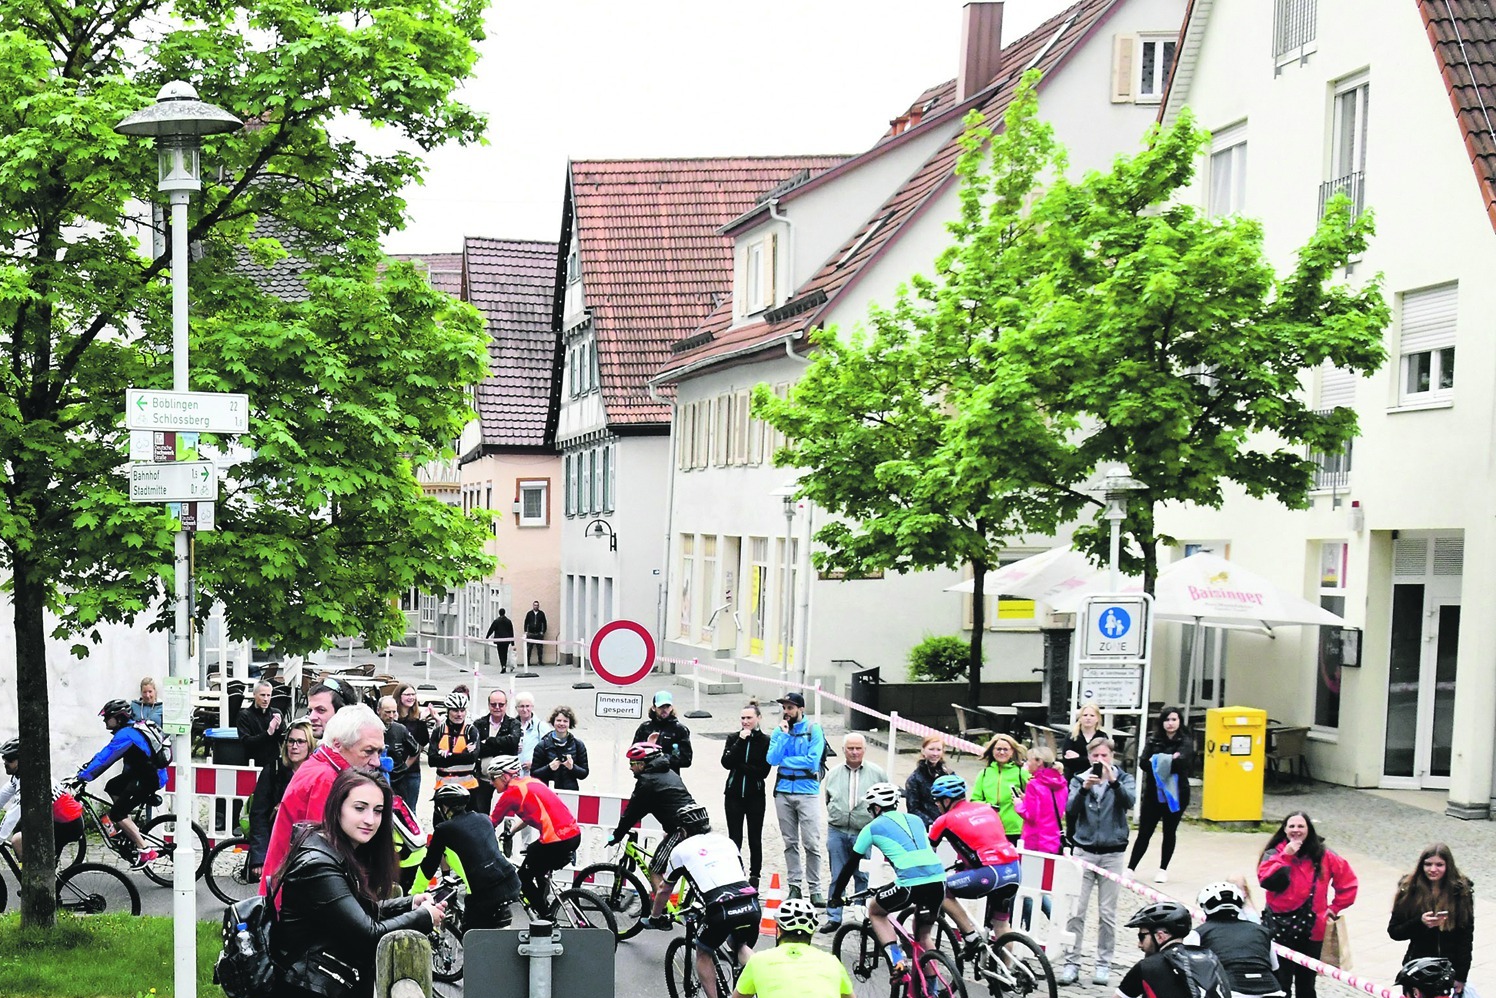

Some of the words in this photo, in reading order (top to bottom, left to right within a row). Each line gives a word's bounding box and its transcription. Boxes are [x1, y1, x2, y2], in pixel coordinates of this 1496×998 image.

[152, 397, 199, 412] Böblingen
[229, 401, 238, 412] 22
[152, 413, 210, 427] Schlossberg
[133, 470, 160, 481] Bahnhof
[133, 484, 167, 496] Stadtmitte
[1187, 585, 1263, 606] Baisinger
[599, 696, 639, 704] Innenstadt
[603, 706, 634, 714] gesperrt
[727, 907, 748, 916] CRAFT
